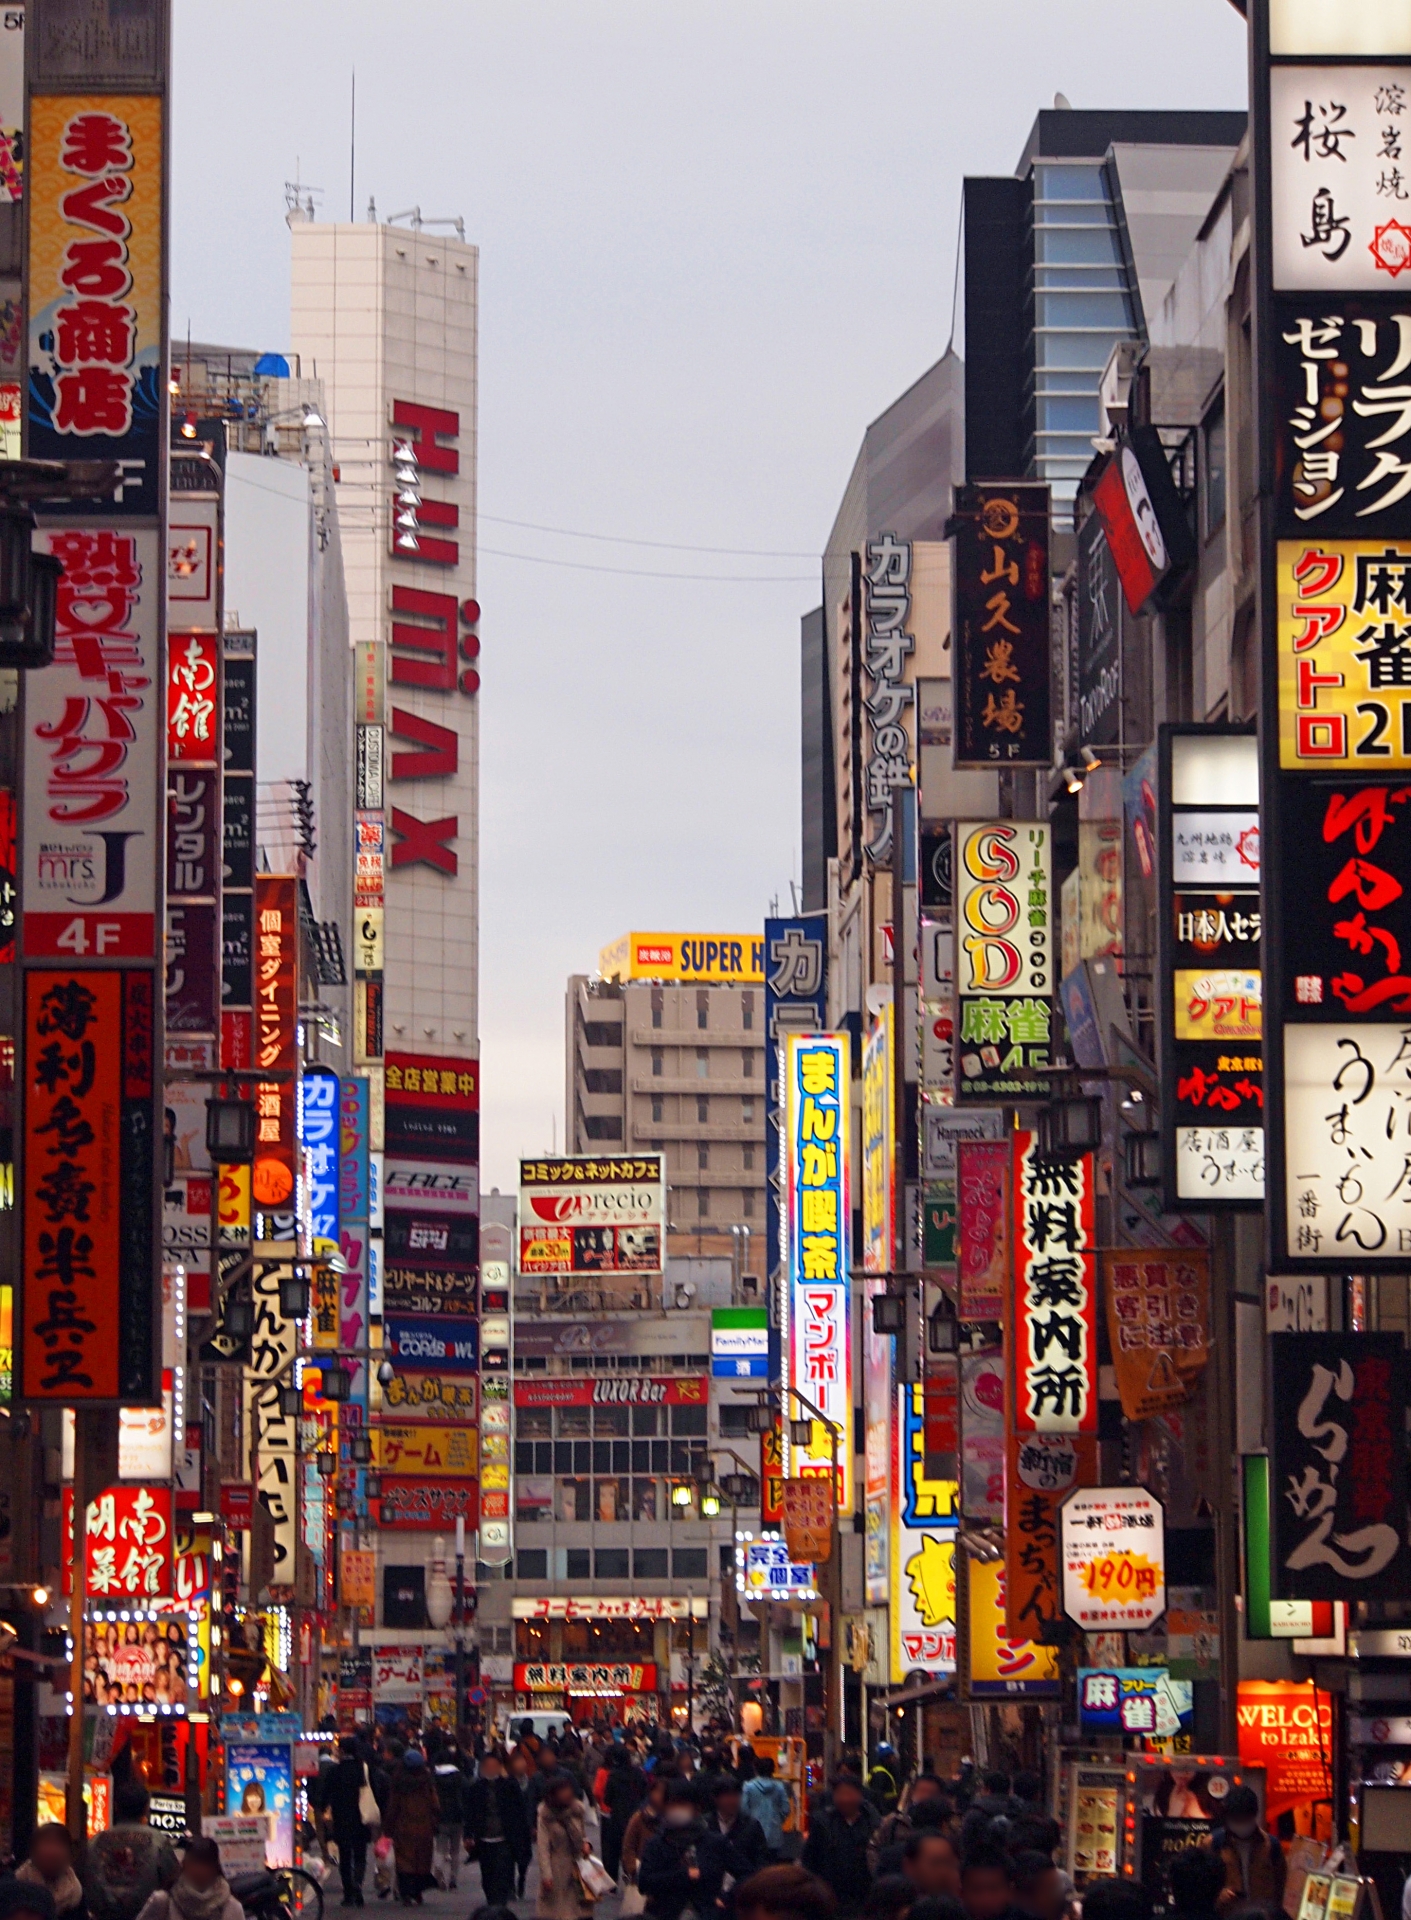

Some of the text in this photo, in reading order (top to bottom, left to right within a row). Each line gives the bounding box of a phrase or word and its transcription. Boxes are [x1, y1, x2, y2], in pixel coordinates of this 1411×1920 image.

[1375, 83, 1409, 200] 溶岩焼
[1291, 100, 1356, 263] 桜島
[54, 112, 135, 437] まぐろ商店
[1294, 548, 1346, 758] クアトロ
[989, 744, 1020, 758] 5F
[174, 776, 206, 891] レンタル
[1028, 829, 1047, 927] リーチ麻雀
[964, 825, 1022, 990] GOD
[56, 917, 122, 955] 4F
[680, 940, 743, 972] SUPER
[258, 909, 282, 1068] 個室ダイニング
[960, 997, 1051, 1044] 麻雀
[386, 1064, 475, 1097] 全店営業中
[303, 1073, 335, 1210] カラオケ
[1180, 1130, 1259, 1153] 居酒屋
[1326, 1038, 1388, 1251] うまいもん
[387, 1171, 477, 1192] FACE
[523, 1160, 659, 1181] コミック&ネットカフェ
[801, 1050, 837, 1281] まんが喫茶
[554, 1186, 653, 1221] aprecio
[1297, 1173, 1324, 1253] 一番街
[1027, 1148, 1084, 1418] 無料案内所
[1114, 1294, 1199, 1320] 客引き
[807, 1291, 836, 1410] マンボー
[1118, 1323, 1203, 1350] に注意
[736, 1359, 752, 1376] 酒
[592, 1379, 668, 1404] LUXOR Bar
[384, 1439, 443, 1466] ゲーム
[87, 1547, 165, 1597] 菜館
[1088, 1558, 1156, 1591] 190円
[526, 1664, 632, 1686] 無料案内所
[1121, 1679, 1158, 1692] フリー
[1083, 1674, 1154, 1732] 麻雀
[1261, 1731, 1279, 1745] to
